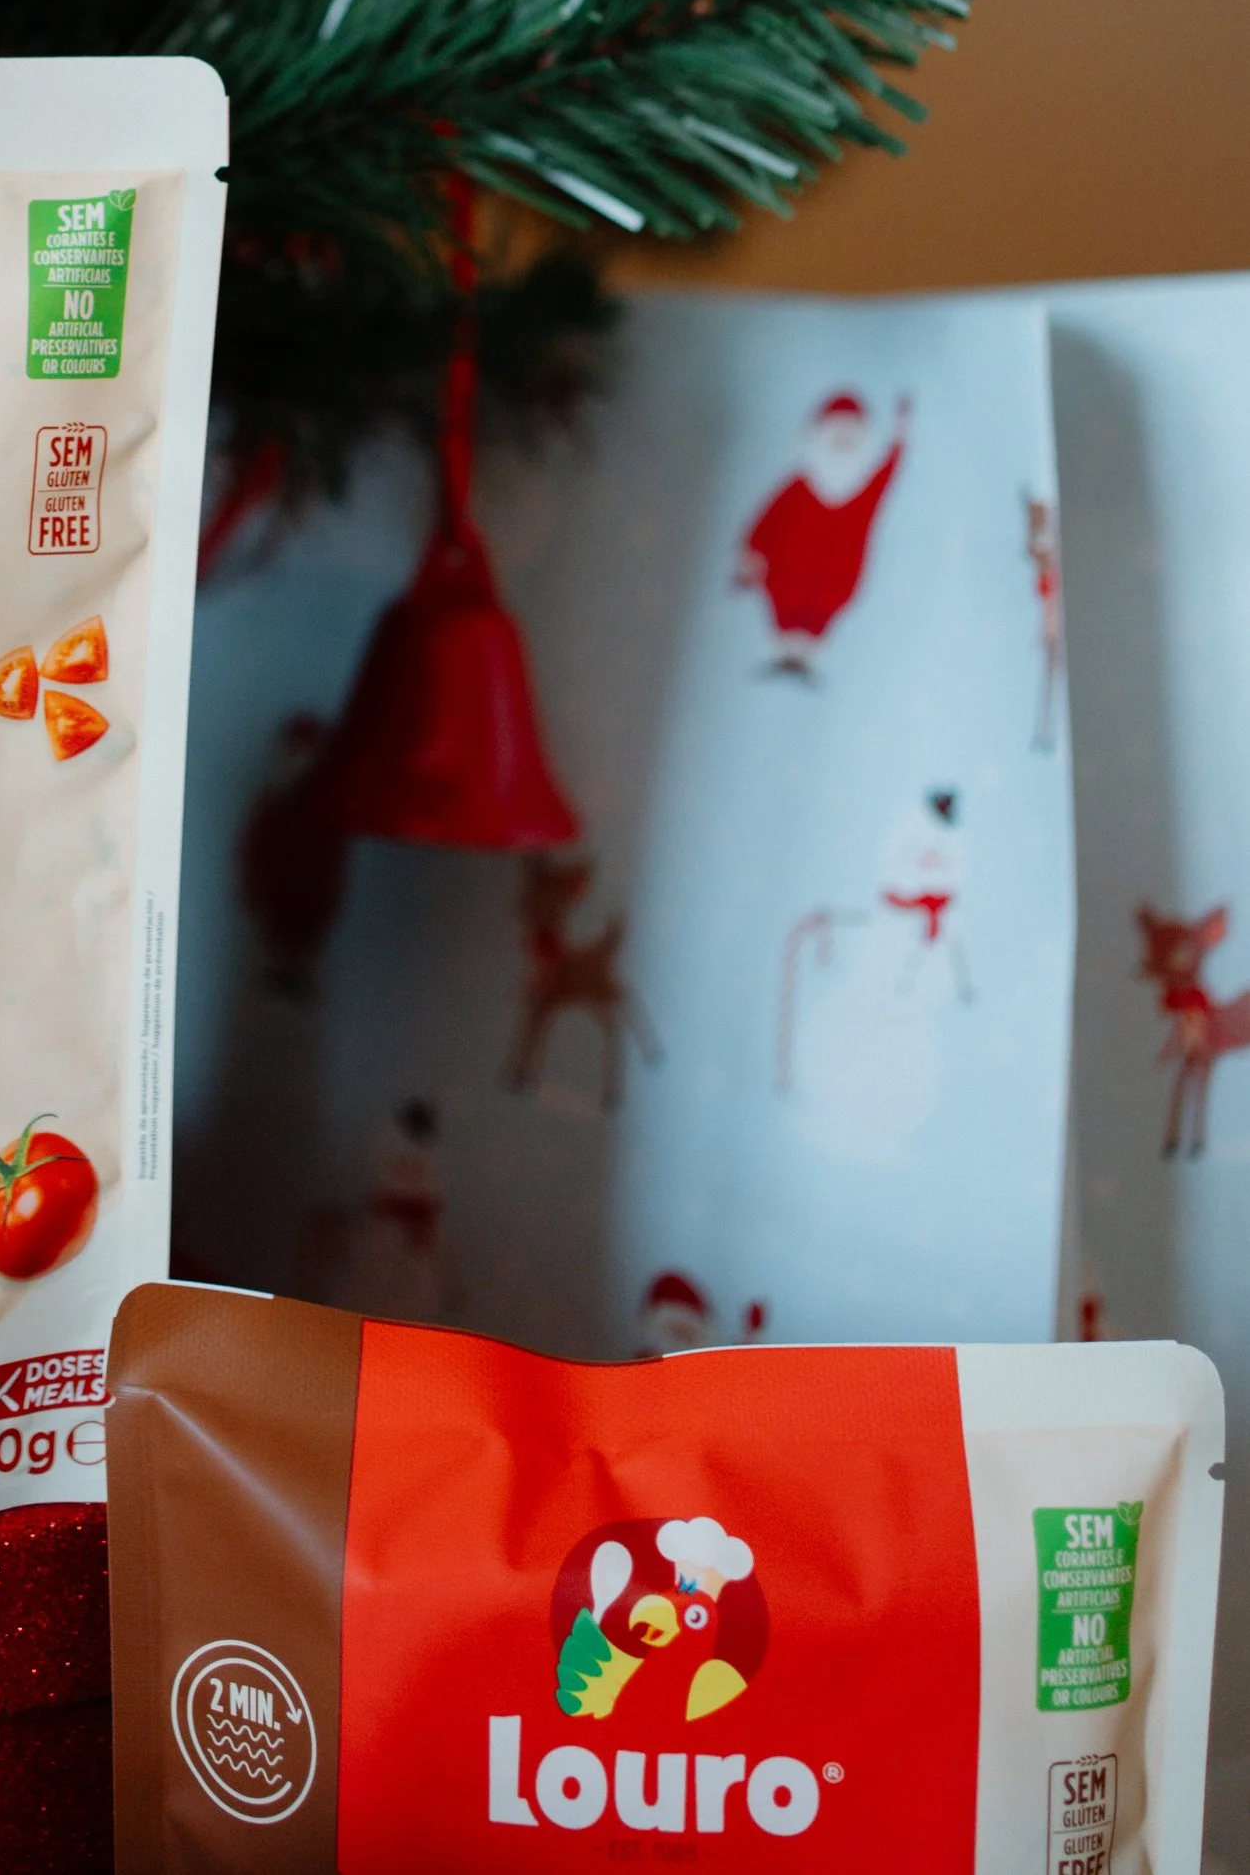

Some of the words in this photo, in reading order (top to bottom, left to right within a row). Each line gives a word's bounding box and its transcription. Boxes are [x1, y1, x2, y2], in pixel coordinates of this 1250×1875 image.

[57, 202, 105, 232] SEM
[46, 232, 106, 248] CORANTES
[109, 232, 116, 247] E
[34, 249, 124, 266] CONSERVANTES
[48, 268, 111, 284] ARTIFICIAIS
[64, 290, 94, 320] NO
[49, 322, 103, 337] ARTIFICIAL
[32, 339, 117, 355] PRESERVATIVES
[42, 359, 58, 374] OR
[60, 358, 105, 374] COLOURS
[49, 436, 93, 467] SEM
[47, 469, 90, 487] GLÚTEN
[45, 496, 85, 512] GLUTEN
[39, 515, 90, 547] FREE
[25, 1353, 105, 1383] DOSES
[23, 1378, 106, 1409] MEALS
[1064, 1514, 1114, 1549] SEM
[1055, 1549, 1114, 1567] CORANTES
[1044, 1566, 1132, 1589] CONSERVANTES
[1073, 1613, 1106, 1646] NO
[1058, 1645, 1114, 1666] ARTIFICIAL
[1041, 1659, 1127, 1687] PRESERVATIVES
[210, 1678, 224, 1713] 2
[230, 1681, 281, 1731] MIN.
[1053, 1688, 1070, 1706] OR
[1064, 1767, 1106, 1805] SEM
[1064, 1832, 1103, 1855] GLUTEN
